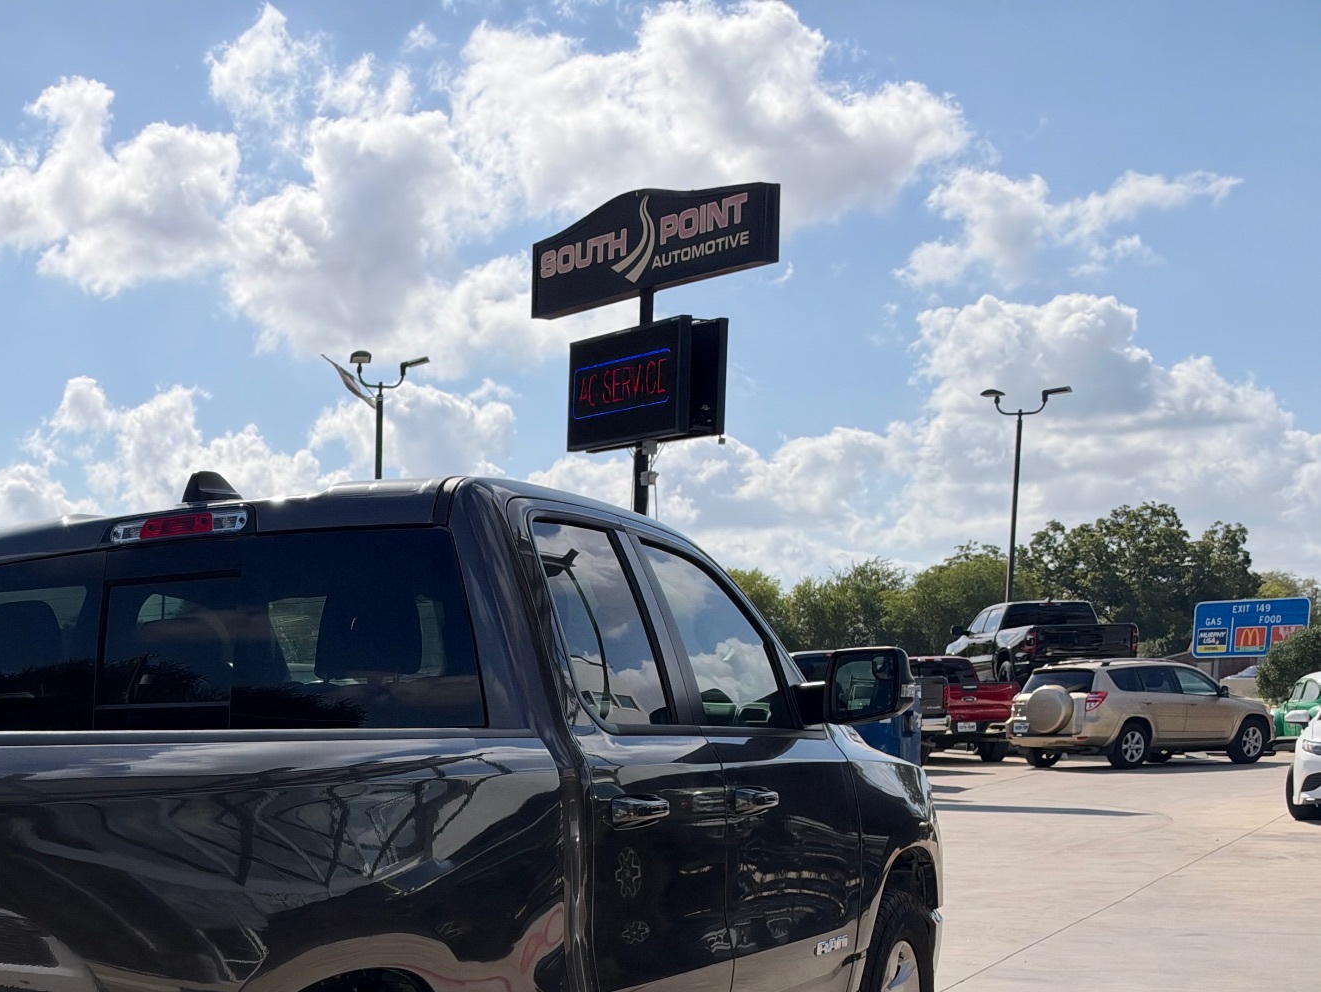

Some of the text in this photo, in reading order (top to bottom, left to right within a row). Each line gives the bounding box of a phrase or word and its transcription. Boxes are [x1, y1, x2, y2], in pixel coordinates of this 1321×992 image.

[540, 192, 748, 279] SOUTH POINT
[651, 230, 750, 270] AUTOMOTIVE
[579, 373, 597, 407] AC
[1232, 604, 1271, 613] EXIT 149
[1259, 615, 1281, 623] FOOD
[1205, 618, 1221, 626] GAS
[816, 934, 848, 955] RAM
